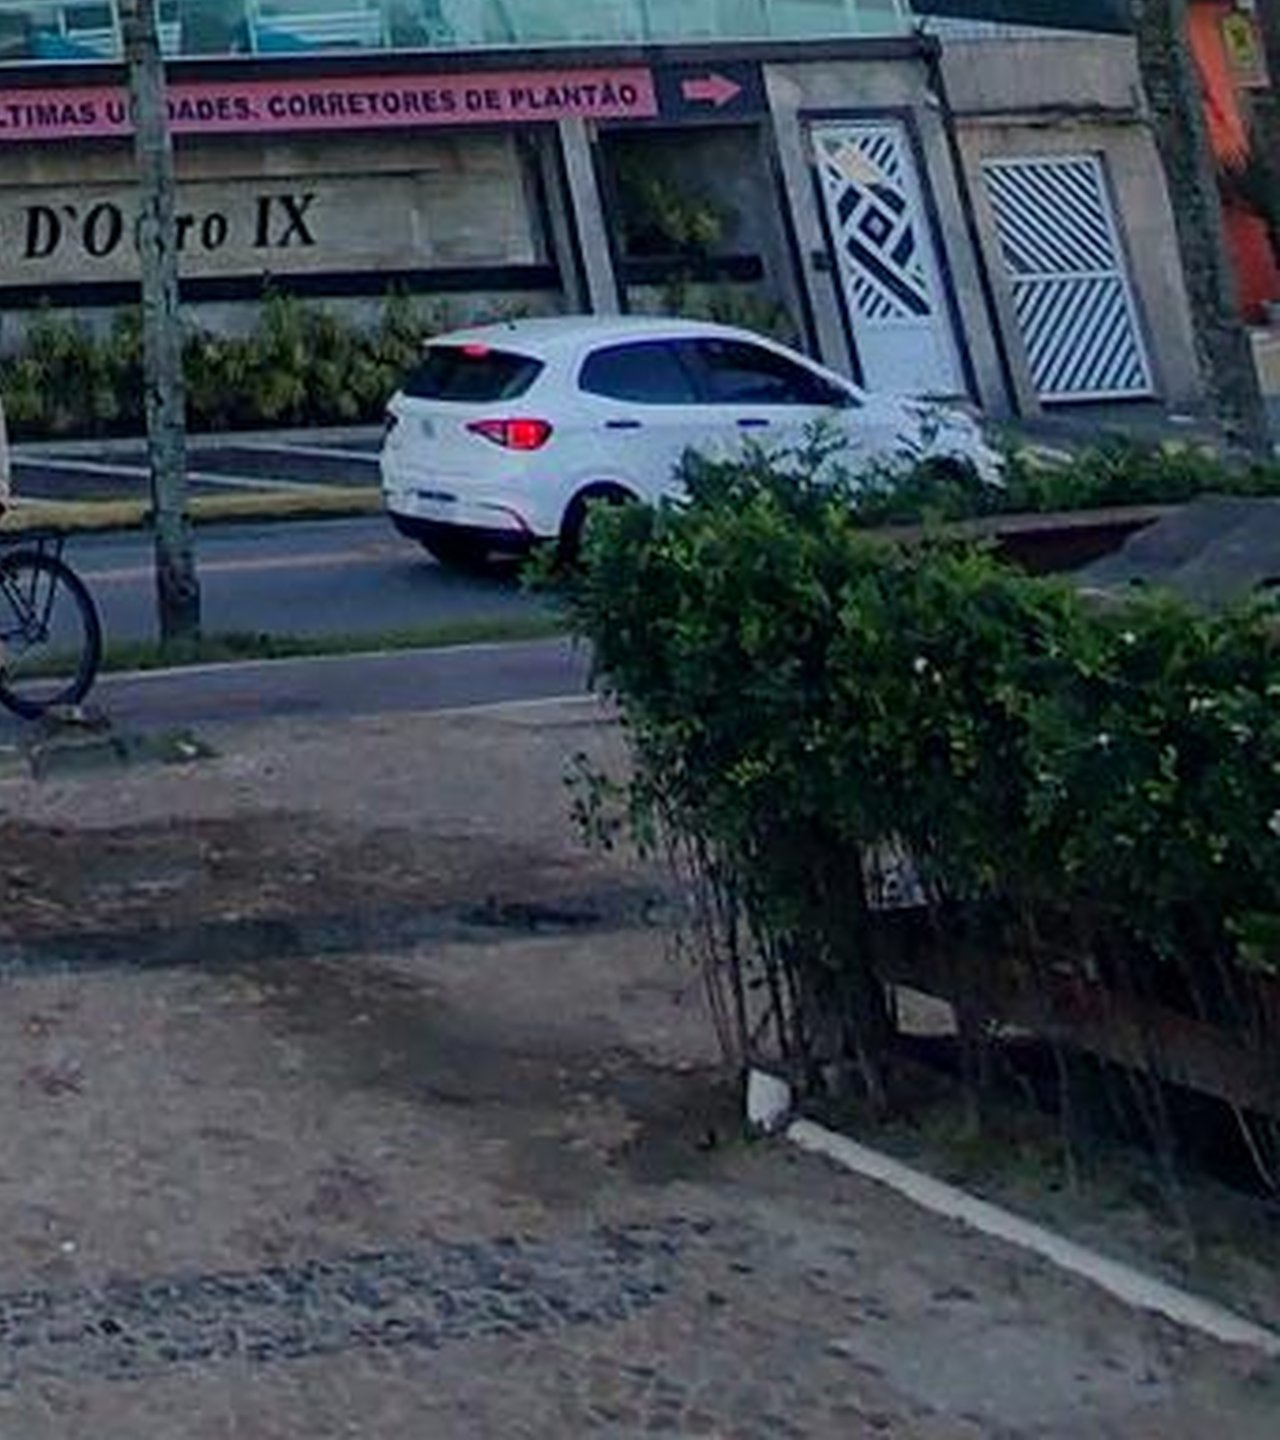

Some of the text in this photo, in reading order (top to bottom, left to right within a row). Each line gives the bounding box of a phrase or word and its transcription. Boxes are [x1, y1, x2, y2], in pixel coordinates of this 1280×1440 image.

[267, 89, 457, 118] CORRETORES
[464, 89, 501, 112] DE
[254, 193, 317, 248] IX
